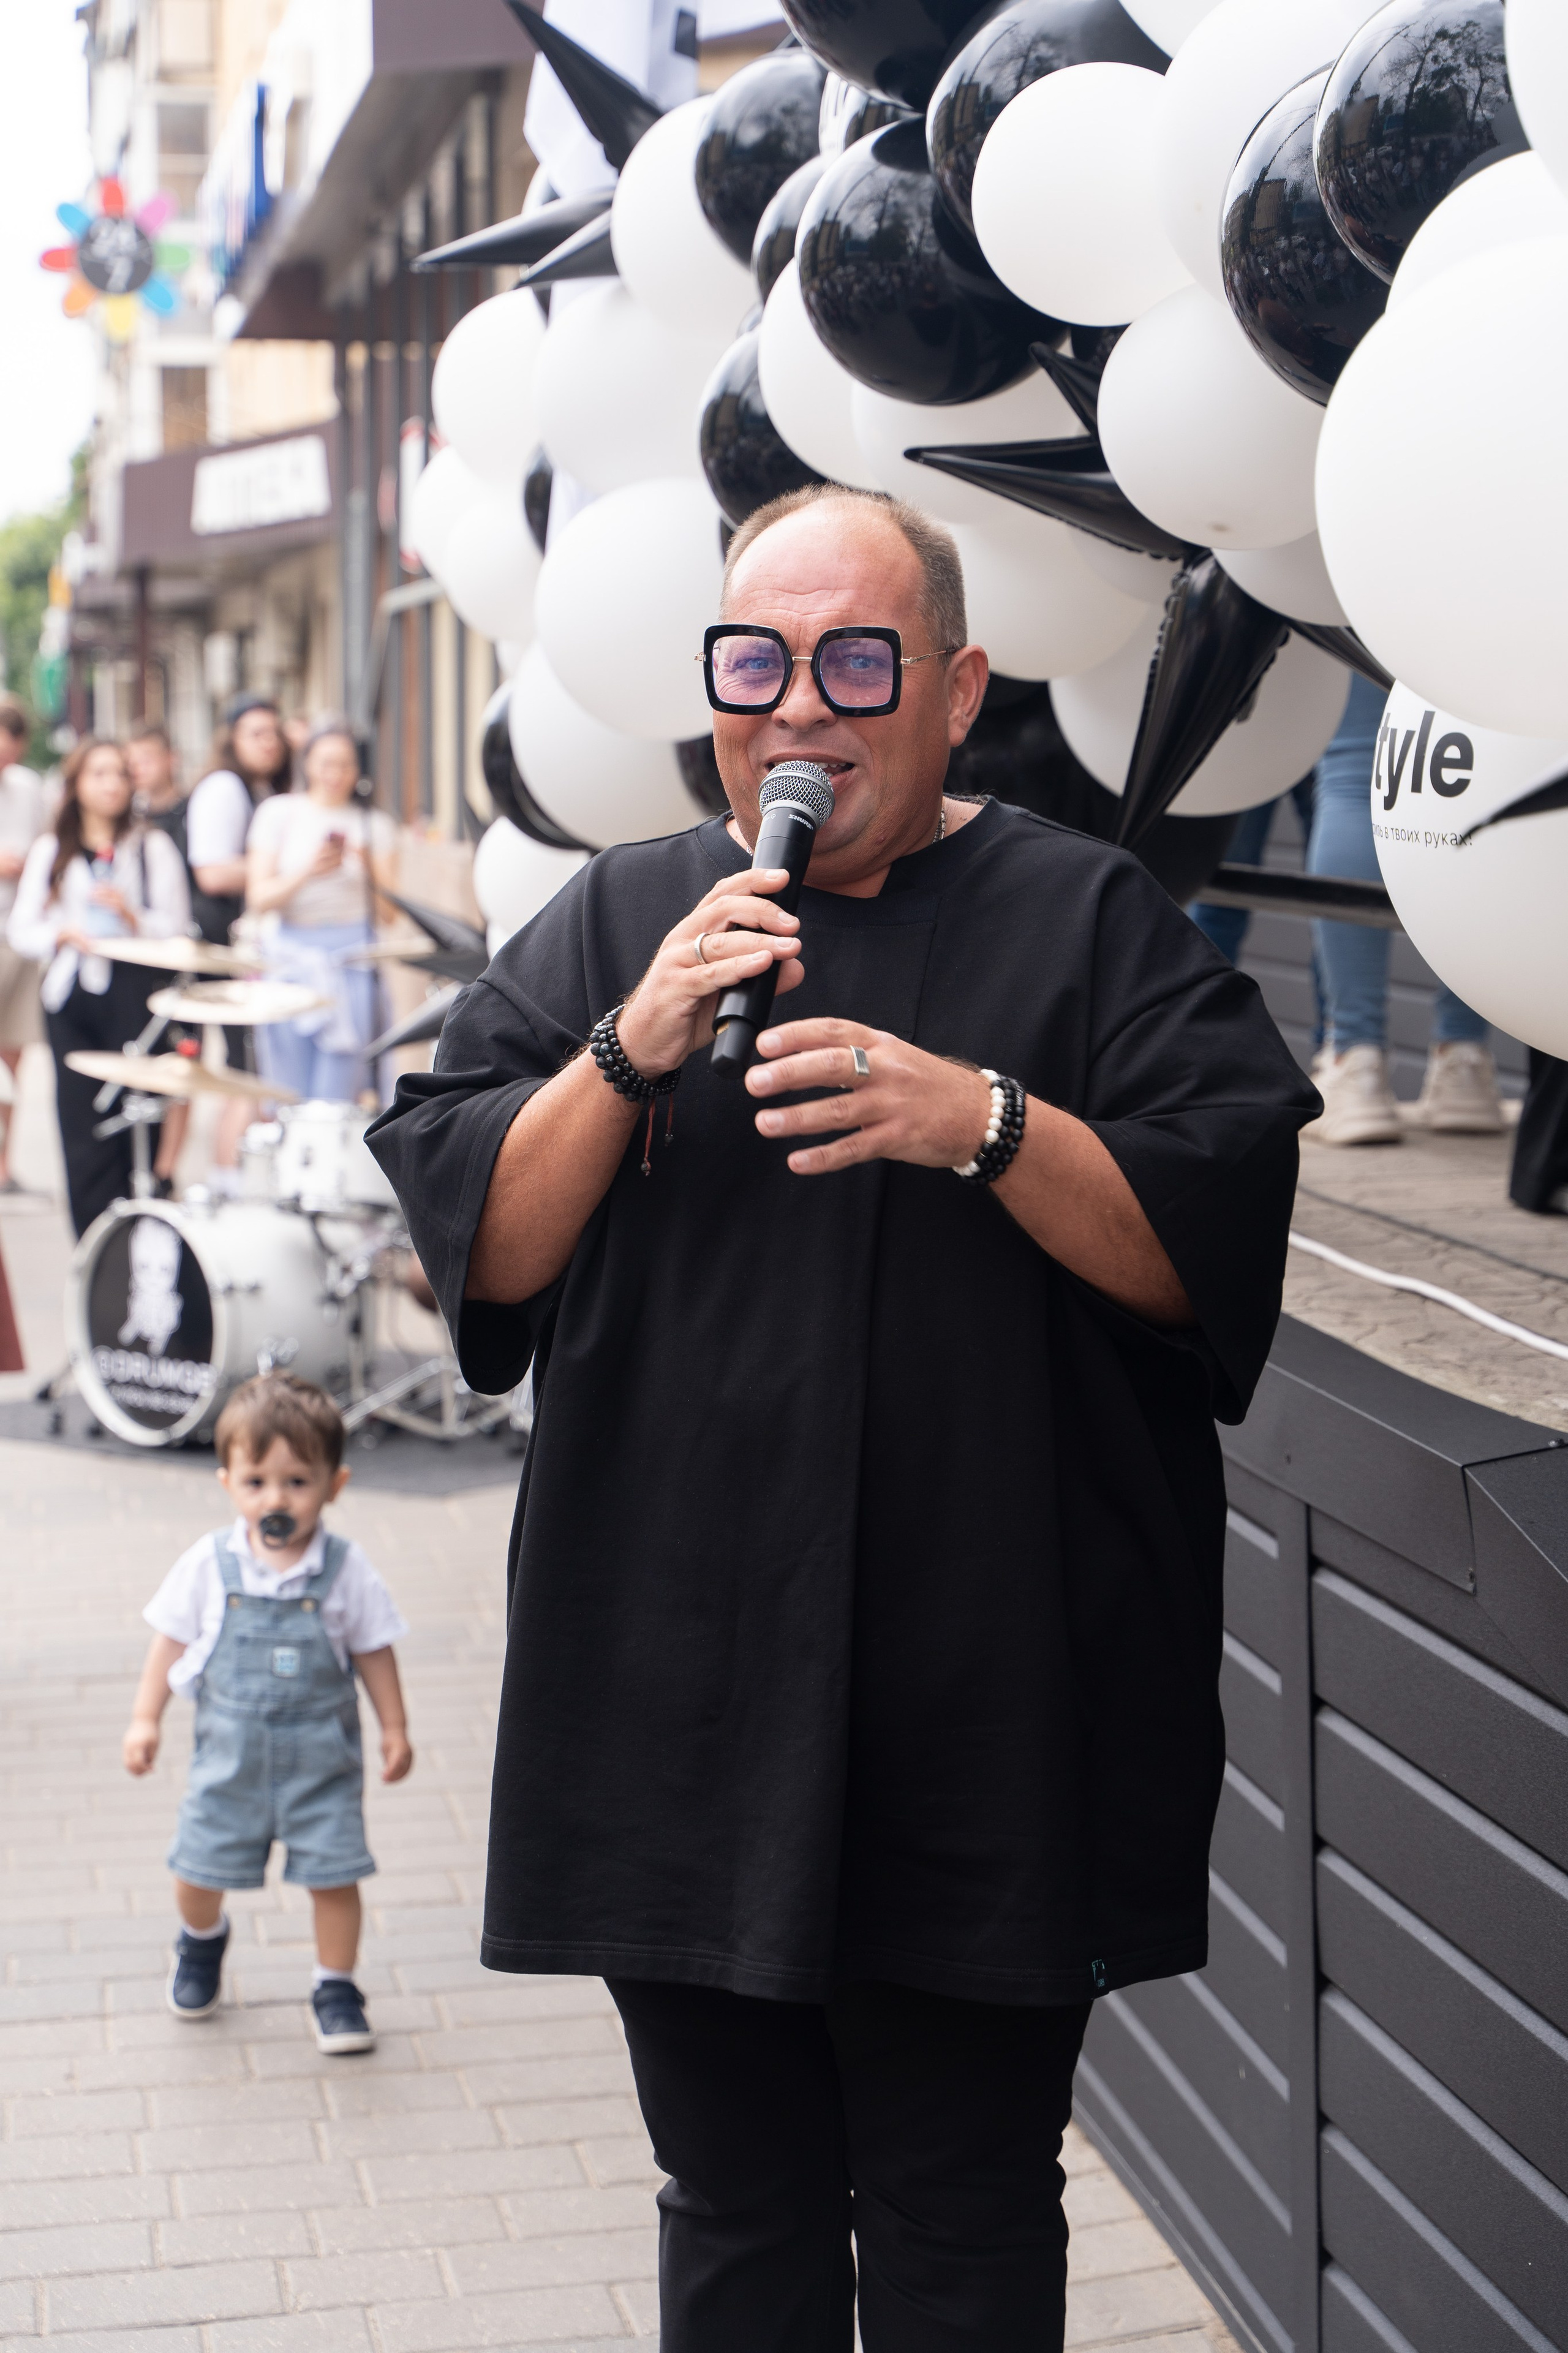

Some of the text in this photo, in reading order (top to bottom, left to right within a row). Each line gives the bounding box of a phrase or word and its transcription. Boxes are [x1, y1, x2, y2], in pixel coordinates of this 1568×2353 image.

[1374, 710, 1474, 810] tyle
[788, 814, 813, 829] SHURE
[1390, 828, 1420, 844] твоих
